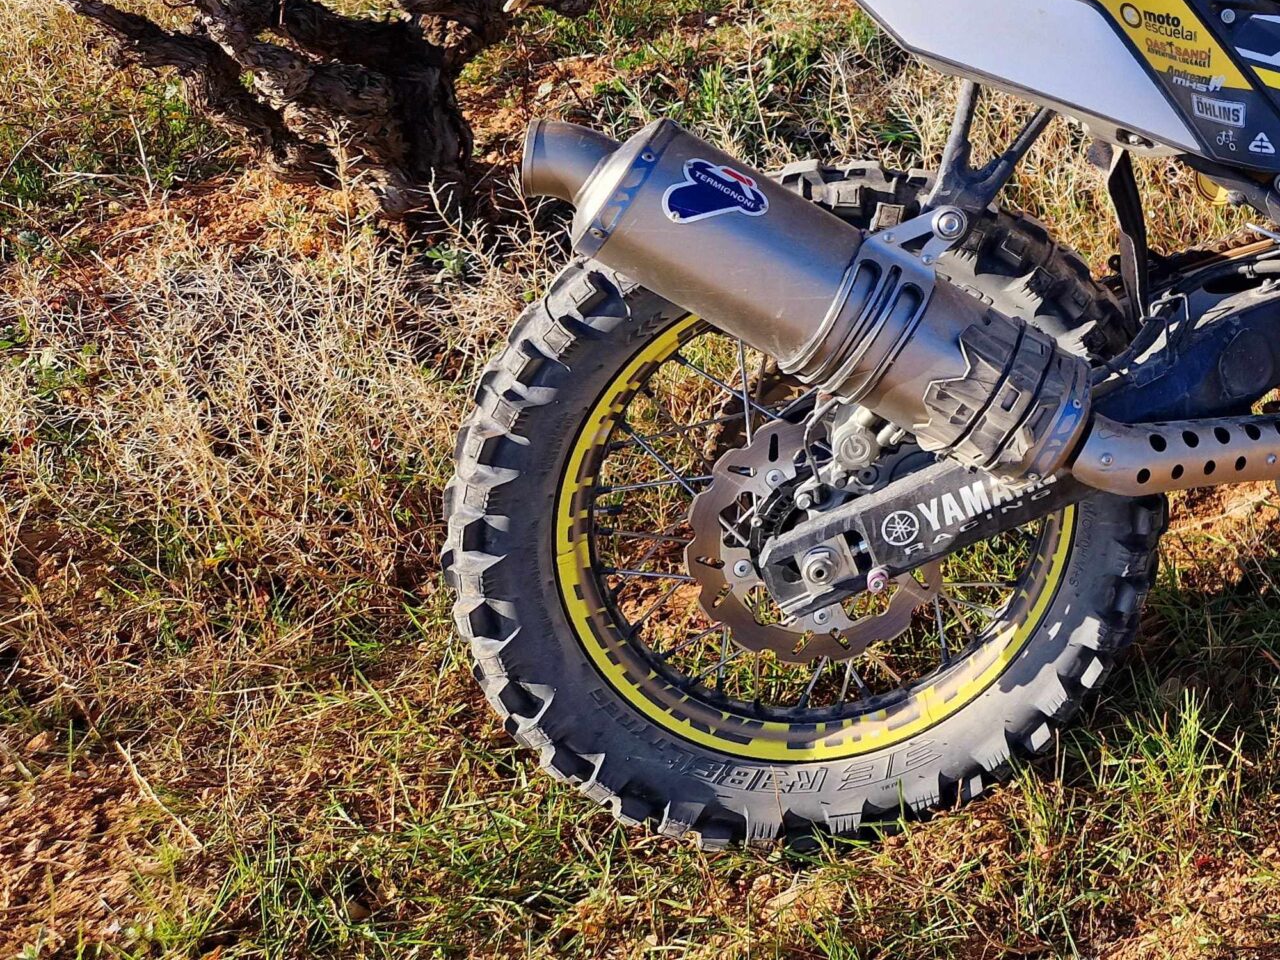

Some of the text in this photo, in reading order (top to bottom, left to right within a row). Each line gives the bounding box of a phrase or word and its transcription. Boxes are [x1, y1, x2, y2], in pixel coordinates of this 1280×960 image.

[1143, 10, 1181, 28] moto
[1144, 21, 1193, 41] escuela
[695, 170, 756, 209] TERMIGNONI
